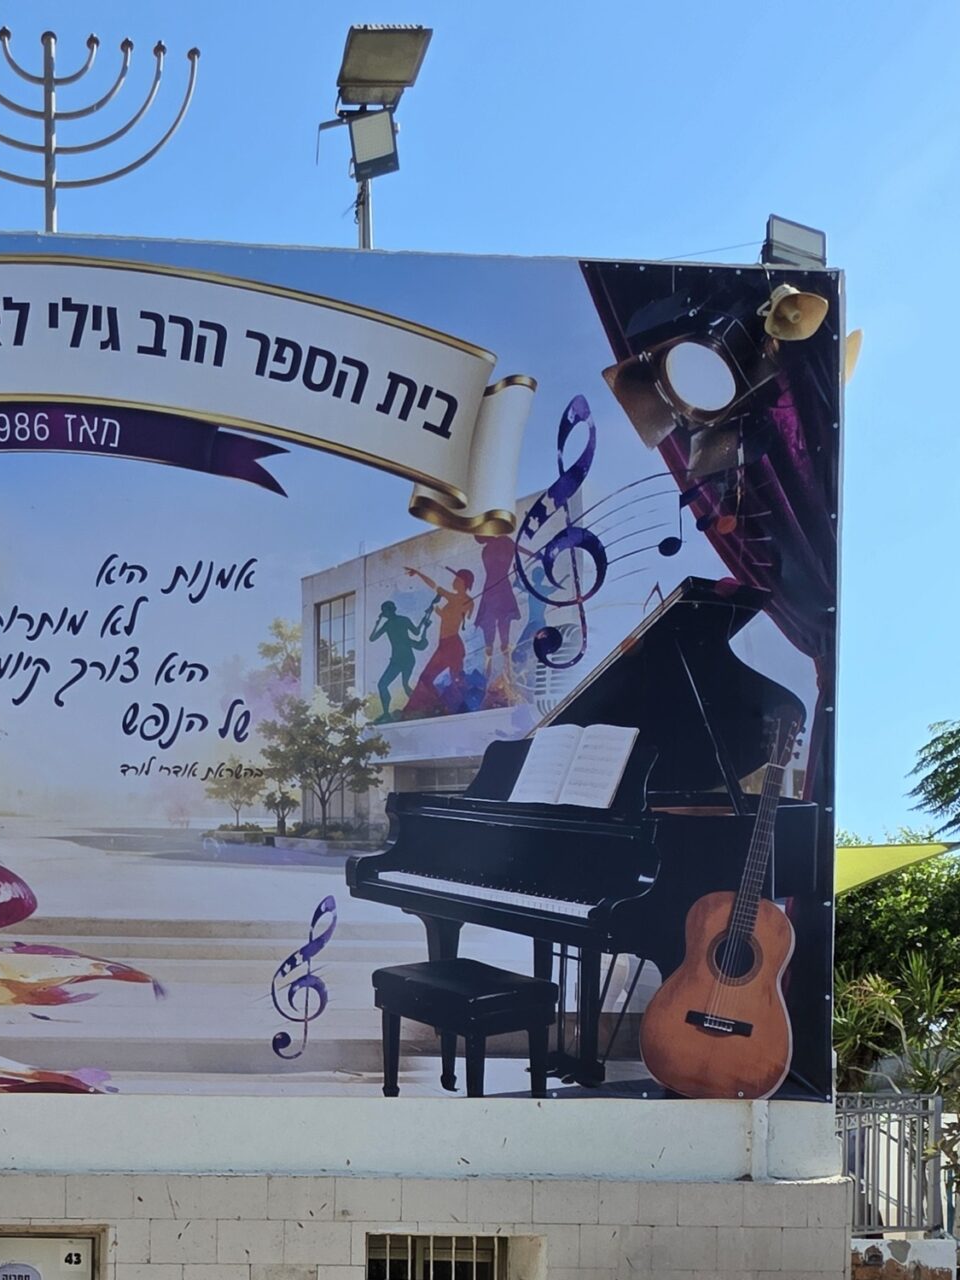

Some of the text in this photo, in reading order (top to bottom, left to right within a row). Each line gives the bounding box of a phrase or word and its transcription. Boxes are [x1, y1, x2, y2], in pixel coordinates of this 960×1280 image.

[47, 296, 121, 352] גילי
[136, 310, 228, 367] הרב
[246, 330, 370, 405] הספר
[376, 370, 460, 441] בית
[63, 416, 122, 448] מאז
[96, 554, 258, 604] אמנות היא
[100, 596, 149, 638] לא
[54, 646, 140, 707] צורך
[154, 652, 209, 686] היא
[122, 698, 251, 750] של הנפש
[120, 756, 264, 781] בהשראת אודרי לורד
[64, 1252, 82, 1265] 43
